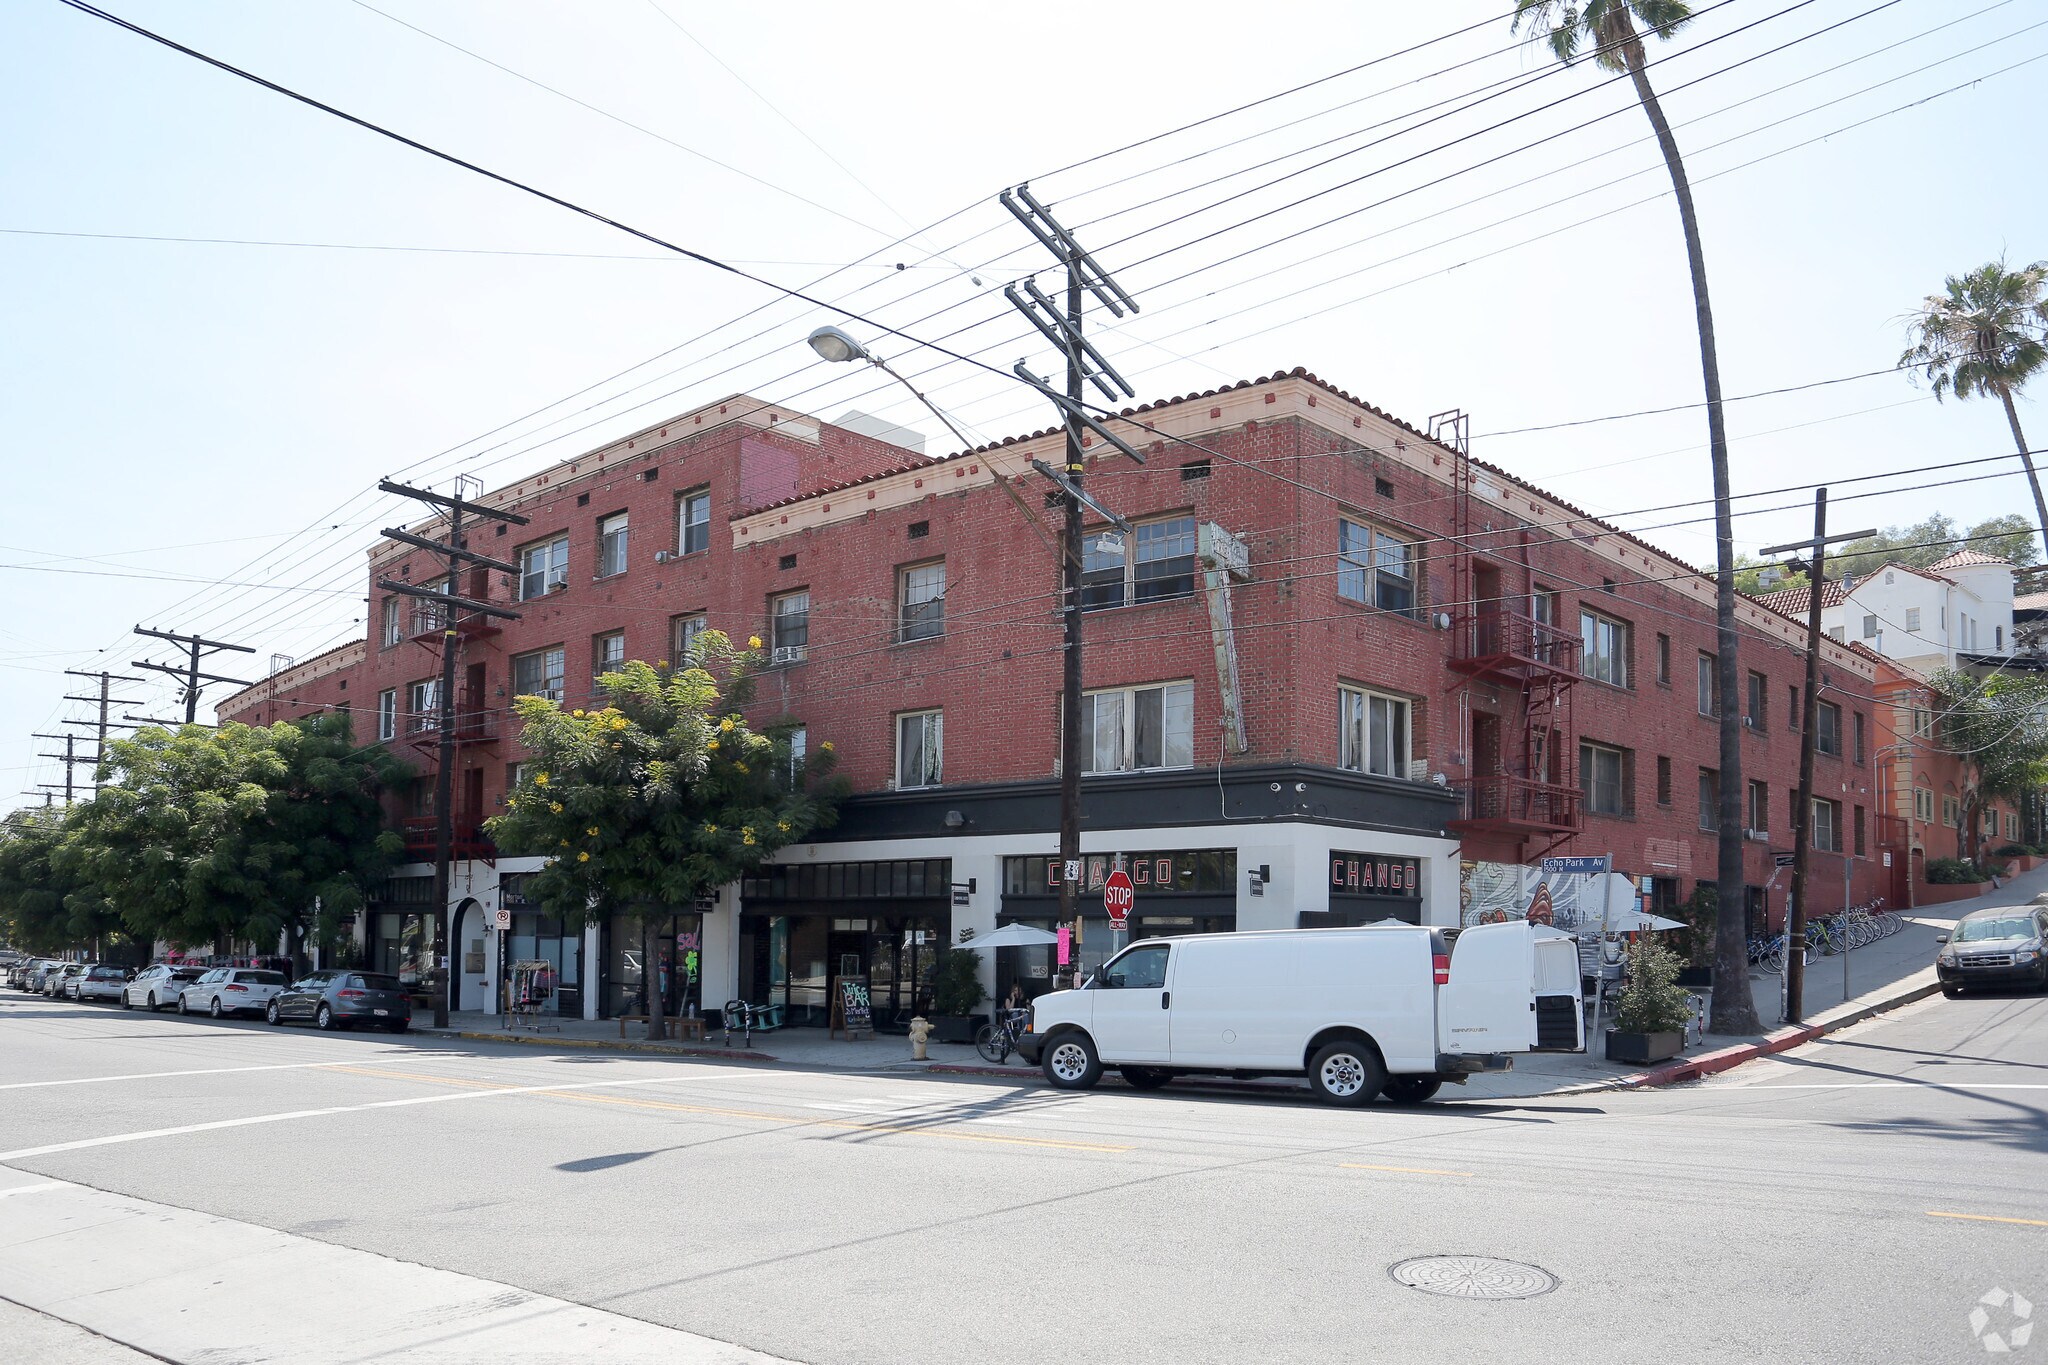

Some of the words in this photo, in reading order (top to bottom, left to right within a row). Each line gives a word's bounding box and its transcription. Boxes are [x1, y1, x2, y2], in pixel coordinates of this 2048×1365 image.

[1543, 859, 1563, 867] Echo
[1565, 858, 1584, 867] Park
[1592, 858, 1603, 866] Av
[1332, 859, 1415, 889] CHANGO
[1106, 885, 1132, 905] STOP
[845, 992, 870, 1007] BAR
